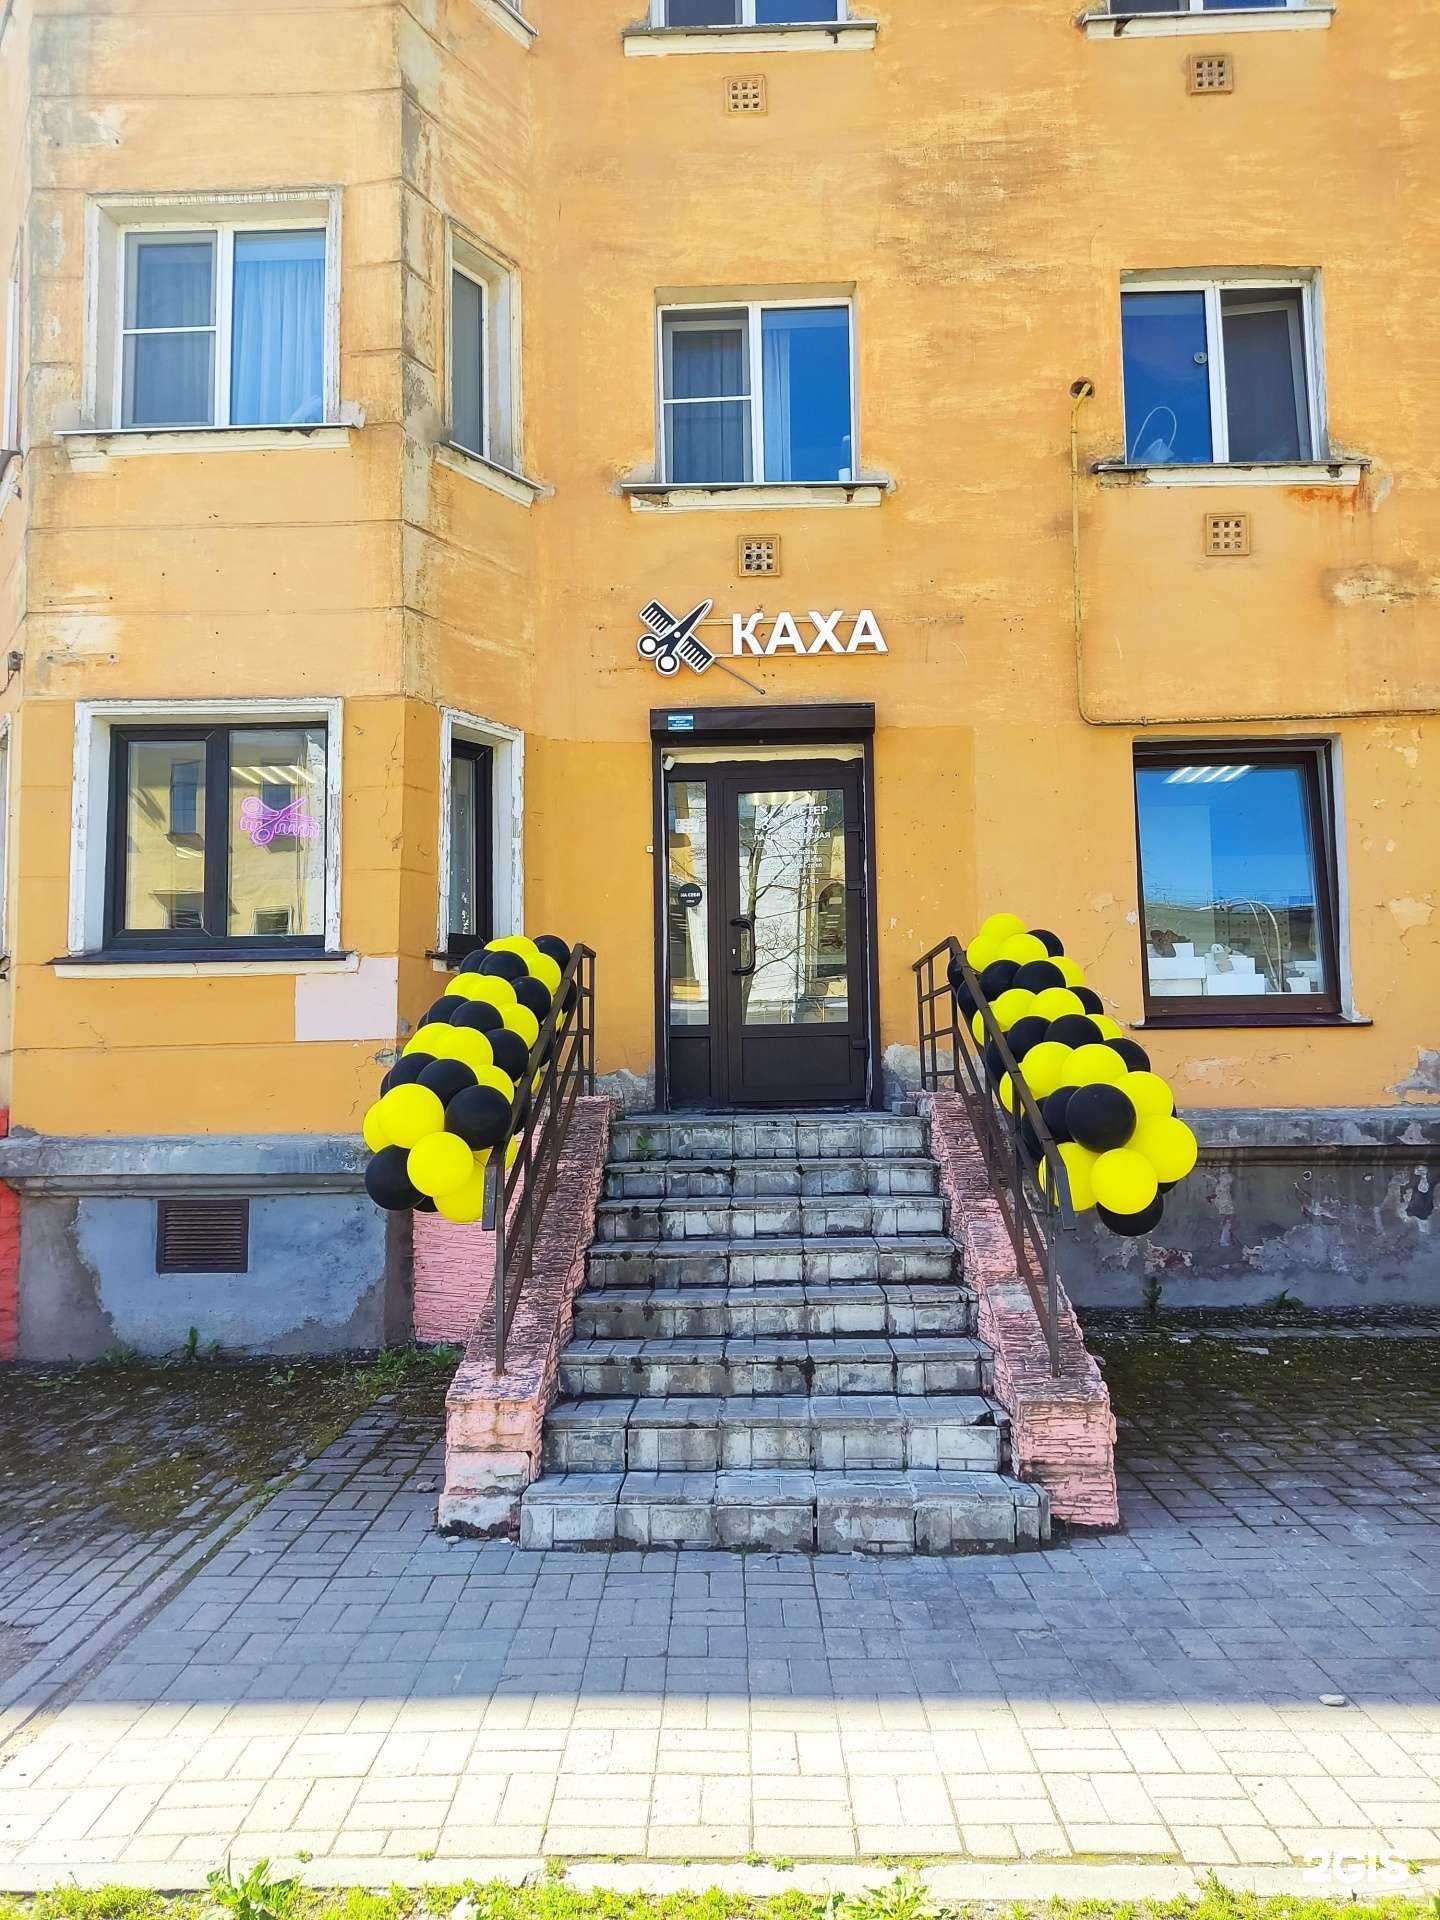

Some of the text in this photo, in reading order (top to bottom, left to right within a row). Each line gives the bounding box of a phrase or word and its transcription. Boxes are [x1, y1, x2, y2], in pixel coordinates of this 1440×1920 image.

[732, 609, 889, 656] КАХА
[782, 805, 828, 816] МАСТЕР
[754, 831, 831, 841] ПАРХЕРСКАЯ
